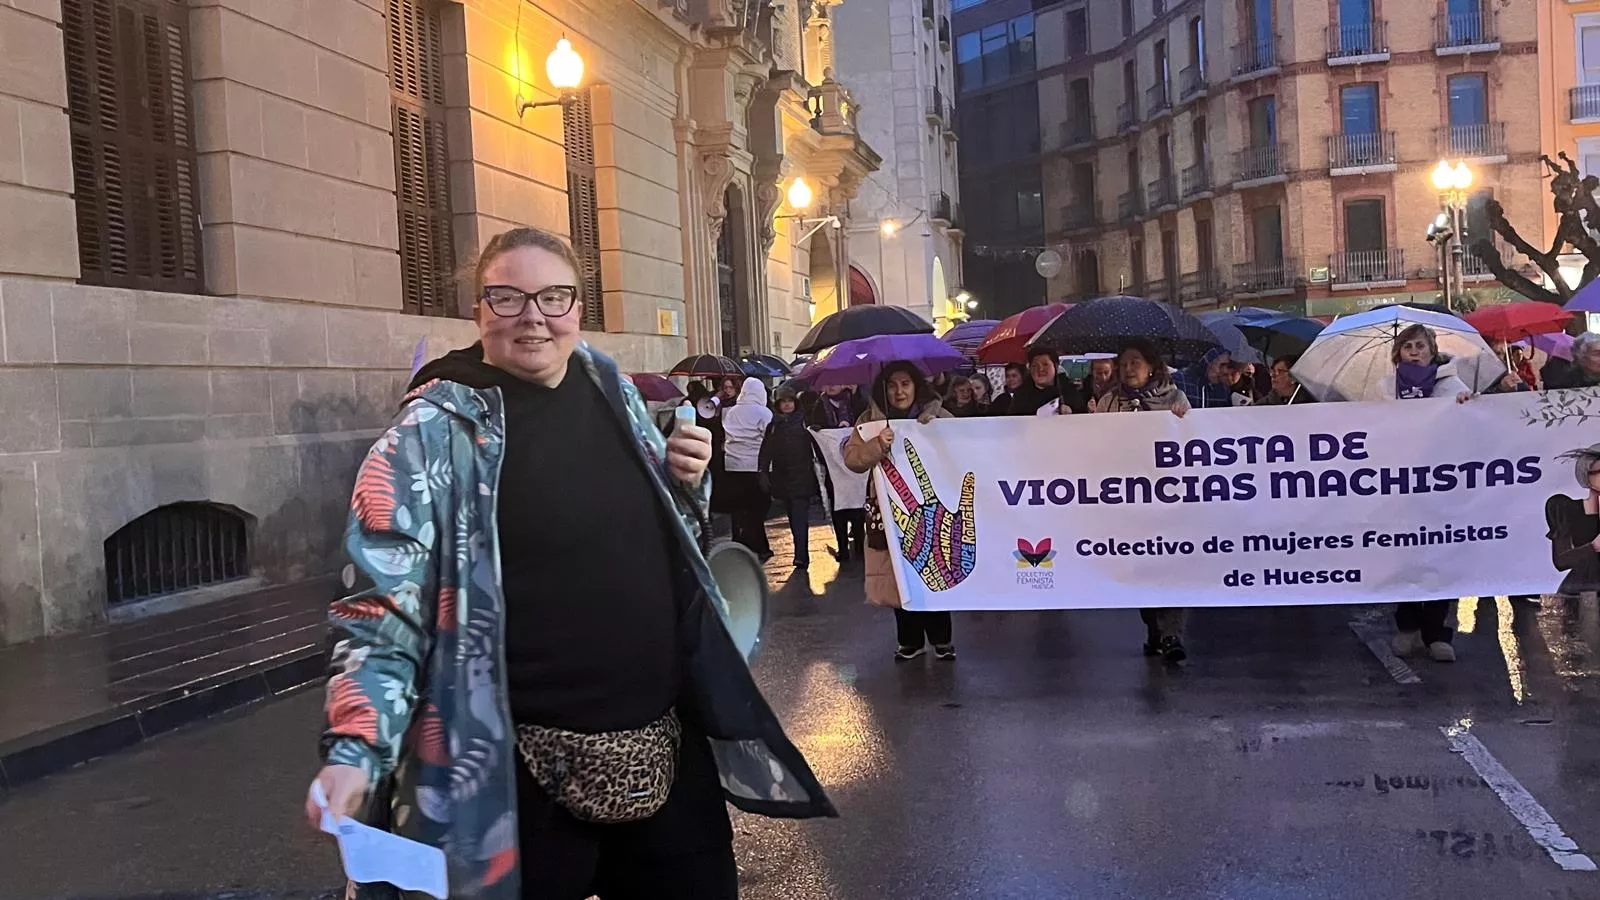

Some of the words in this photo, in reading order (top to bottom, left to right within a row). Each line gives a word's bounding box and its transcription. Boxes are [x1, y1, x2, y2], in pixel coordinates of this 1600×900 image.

[1154, 434, 1295, 469] BASTA
[1308, 431, 1370, 462] DE
[997, 473, 1258, 506] VIOLENCIAS
[1270, 455, 1542, 499] MACHISTAS
[1075, 535, 1195, 557] Colectivo
[1202, 535, 1235, 554] de
[1242, 531, 1355, 555] Mujeres
[1362, 523, 1509, 548] Feministas
[1223, 569, 1256, 588] de
[1263, 568, 1362, 586] Huesca
